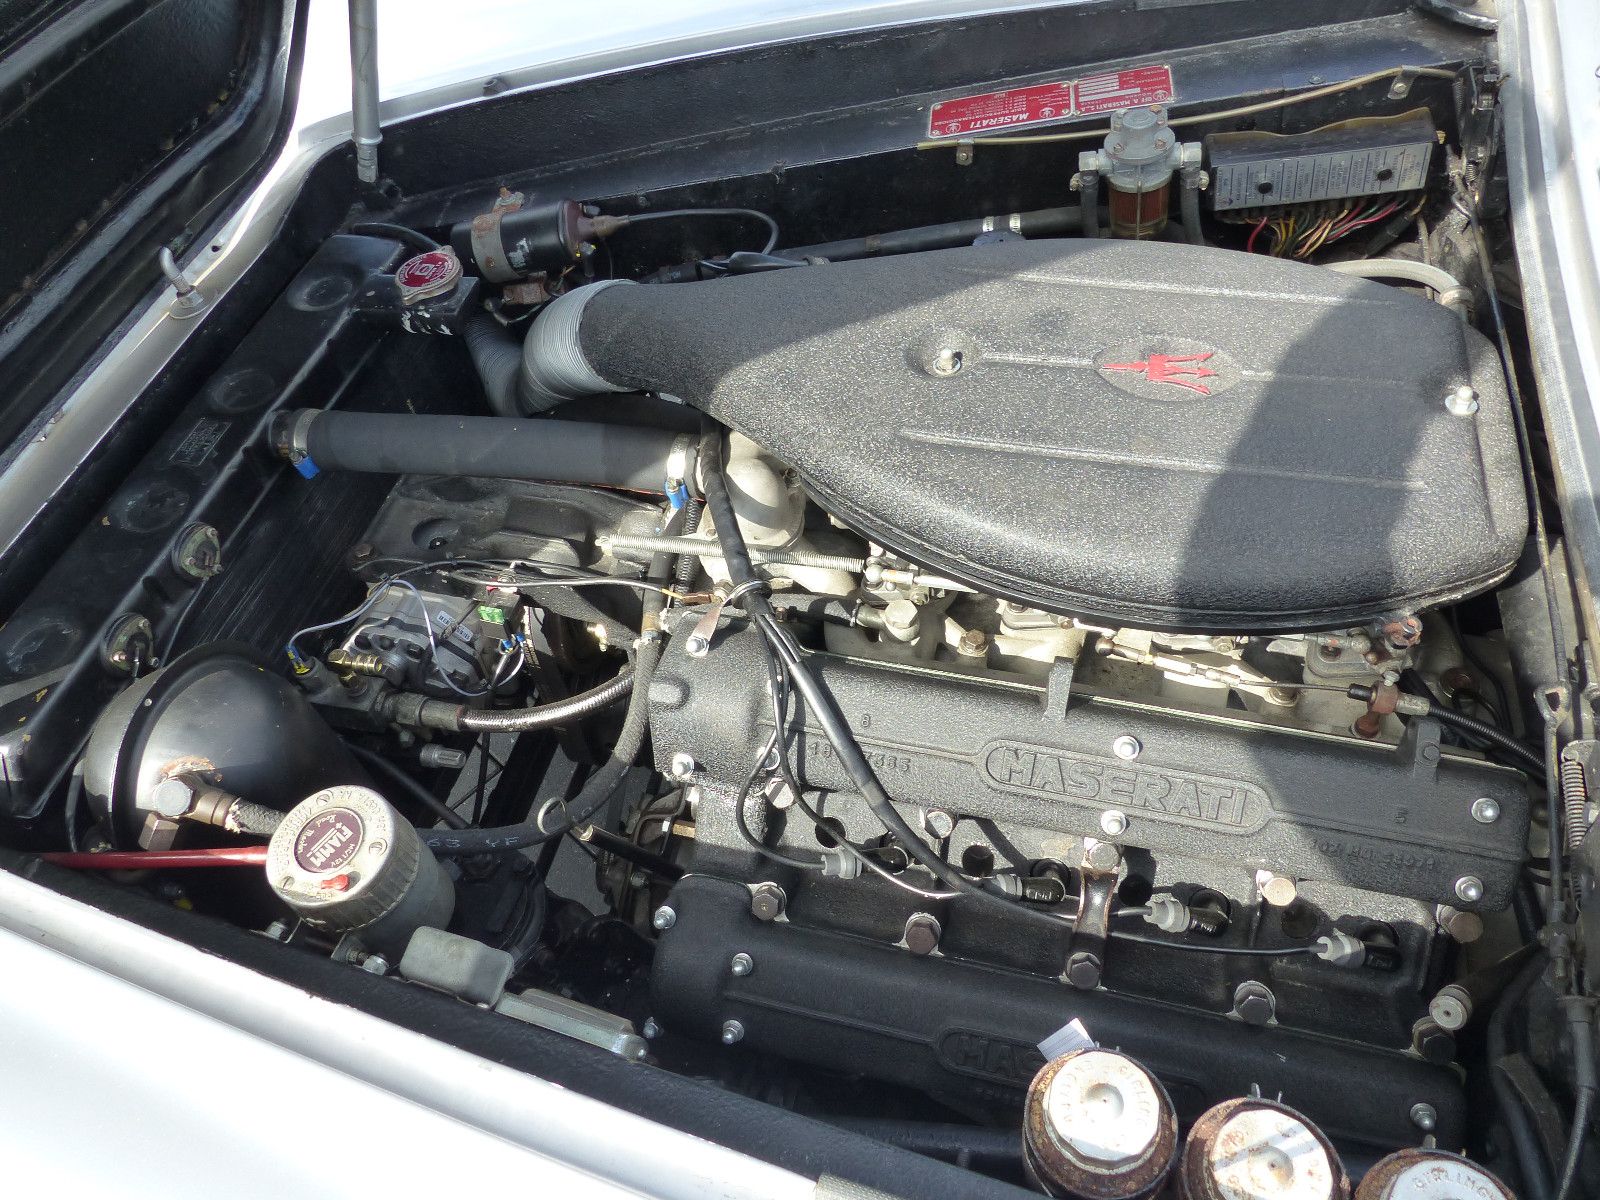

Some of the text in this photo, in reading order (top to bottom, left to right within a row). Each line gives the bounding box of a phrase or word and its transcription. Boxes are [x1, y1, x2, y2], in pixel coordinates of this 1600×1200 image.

[970, 112, 1029, 129] MASERATI
[1002, 747, 1248, 827] MASERATI
[310, 825, 354, 867] FIAMM
